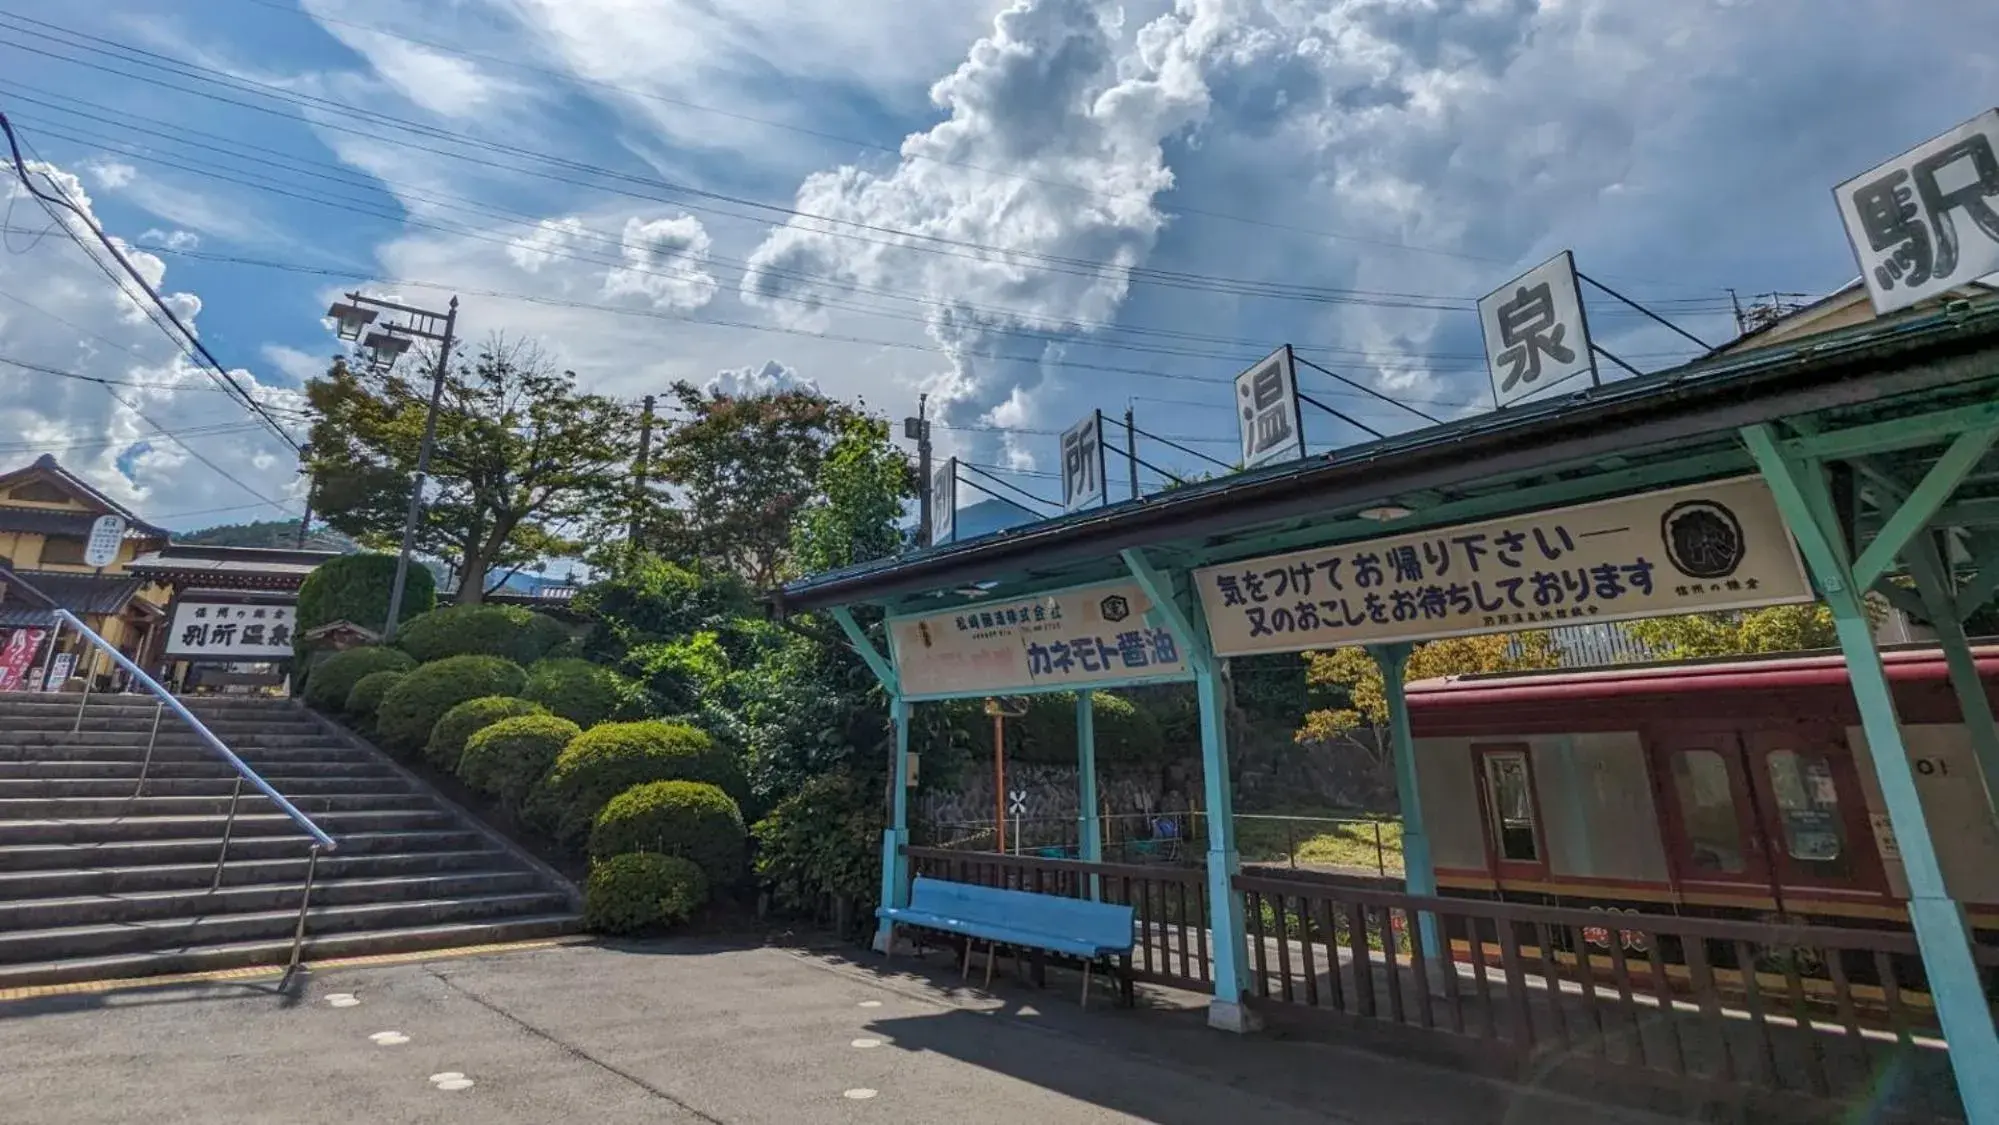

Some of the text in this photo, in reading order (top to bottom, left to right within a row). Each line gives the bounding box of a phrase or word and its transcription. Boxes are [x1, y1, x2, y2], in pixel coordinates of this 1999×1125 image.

[1064, 419, 1095, 507] 所
[1240, 359, 1293, 458] 温
[1496, 281, 1576, 394] 泉
[1852, 132, 1999, 292] 駅
[1245, 557, 1655, 637] 又のおこしをお待ちしております
[182, 623, 291, 647] 別所温泉
[1027, 626, 1178, 675] カネモト醤油
